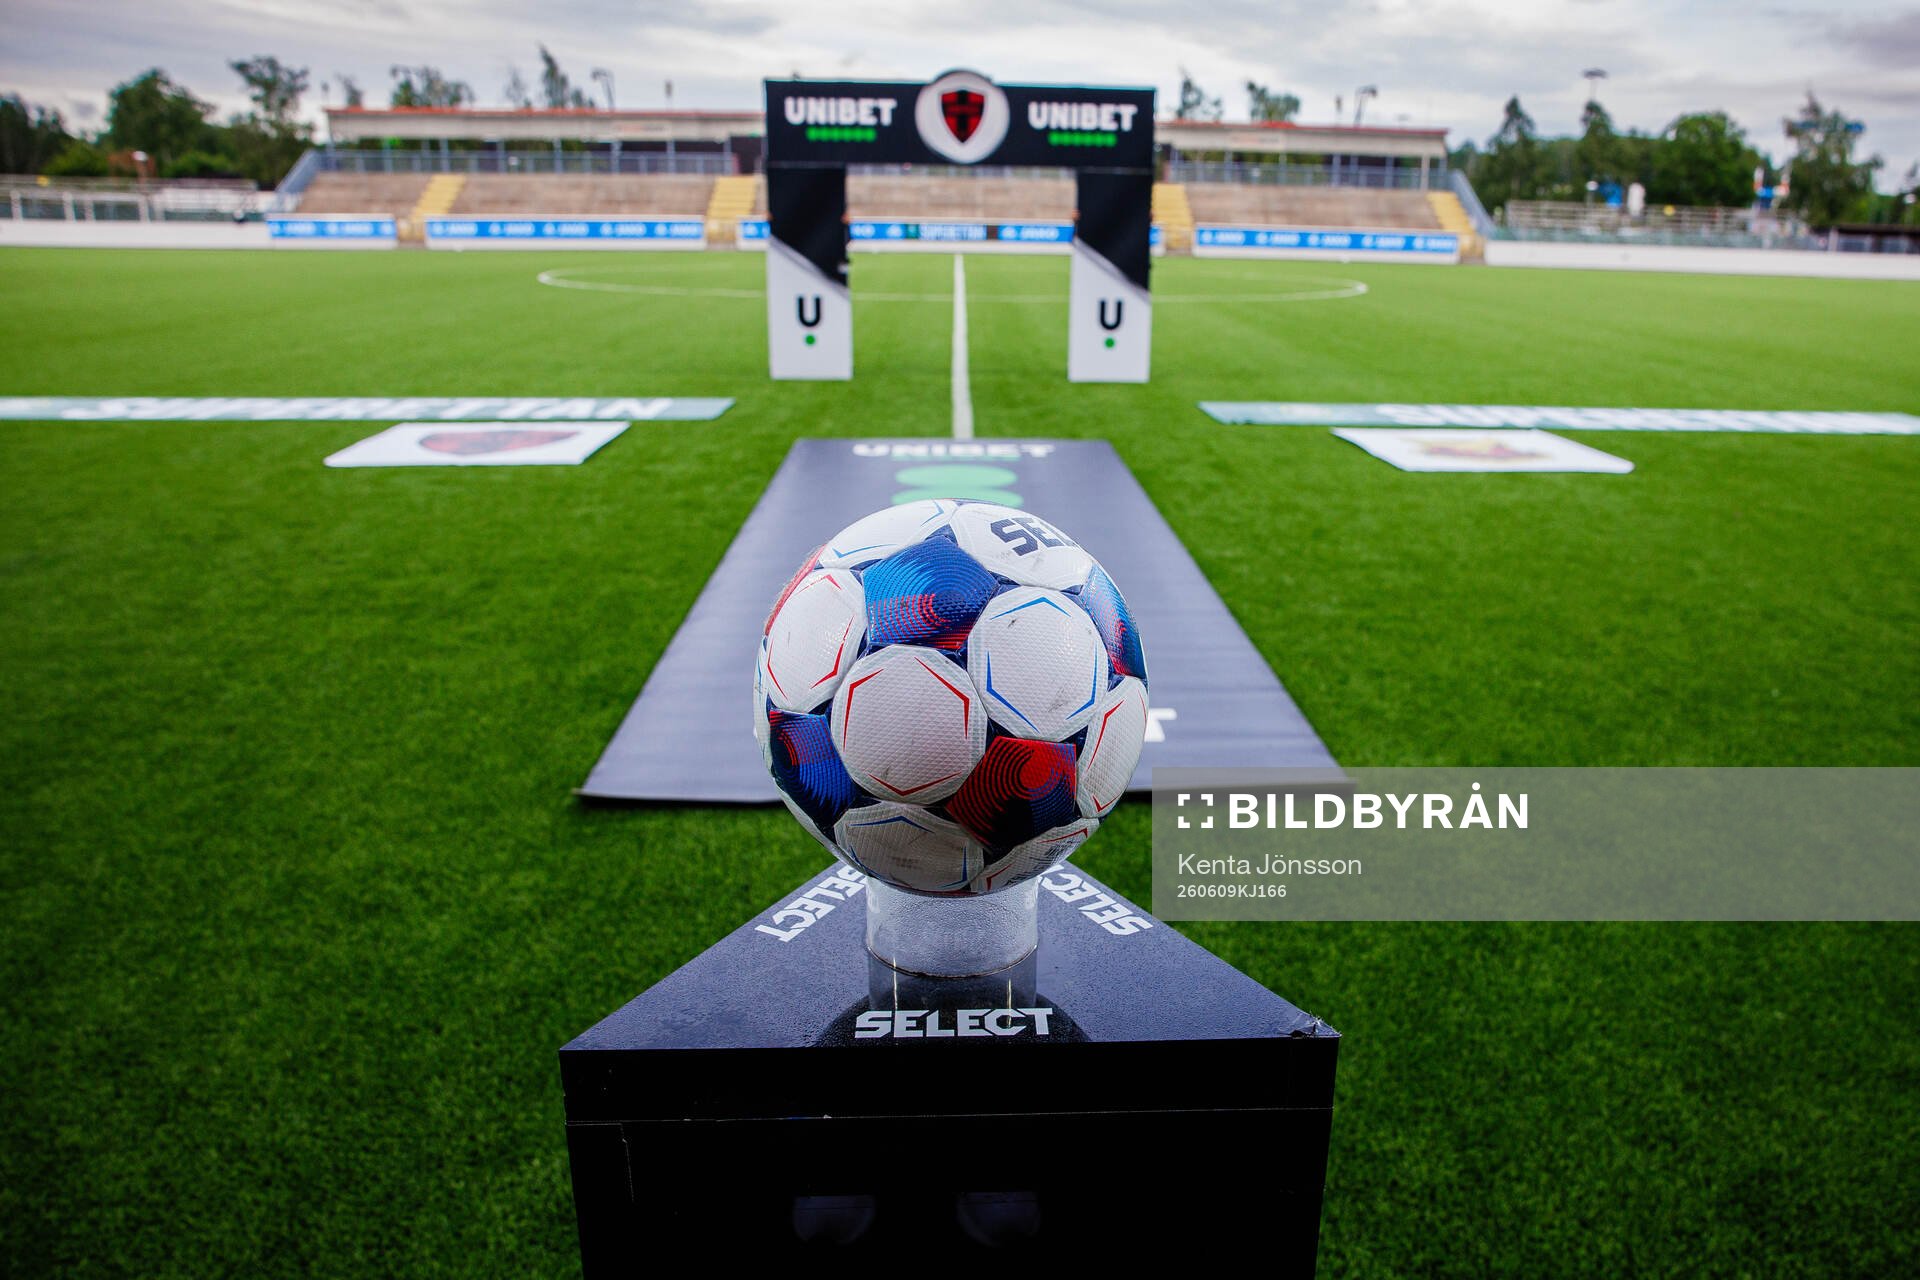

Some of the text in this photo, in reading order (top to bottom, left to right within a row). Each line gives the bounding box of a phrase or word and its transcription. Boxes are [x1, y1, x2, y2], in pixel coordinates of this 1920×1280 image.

[784, 97, 898, 127] UNIBET
[1027, 101, 1139, 132] UNIBET
[797, 295, 823, 328] U
[1098, 299, 1124, 331] U
[853, 443, 1056, 458] UNIBET
[990, 518, 1078, 556] SEL
[754, 864, 869, 942] SELECT
[854, 1007, 1053, 1039] SELECT
